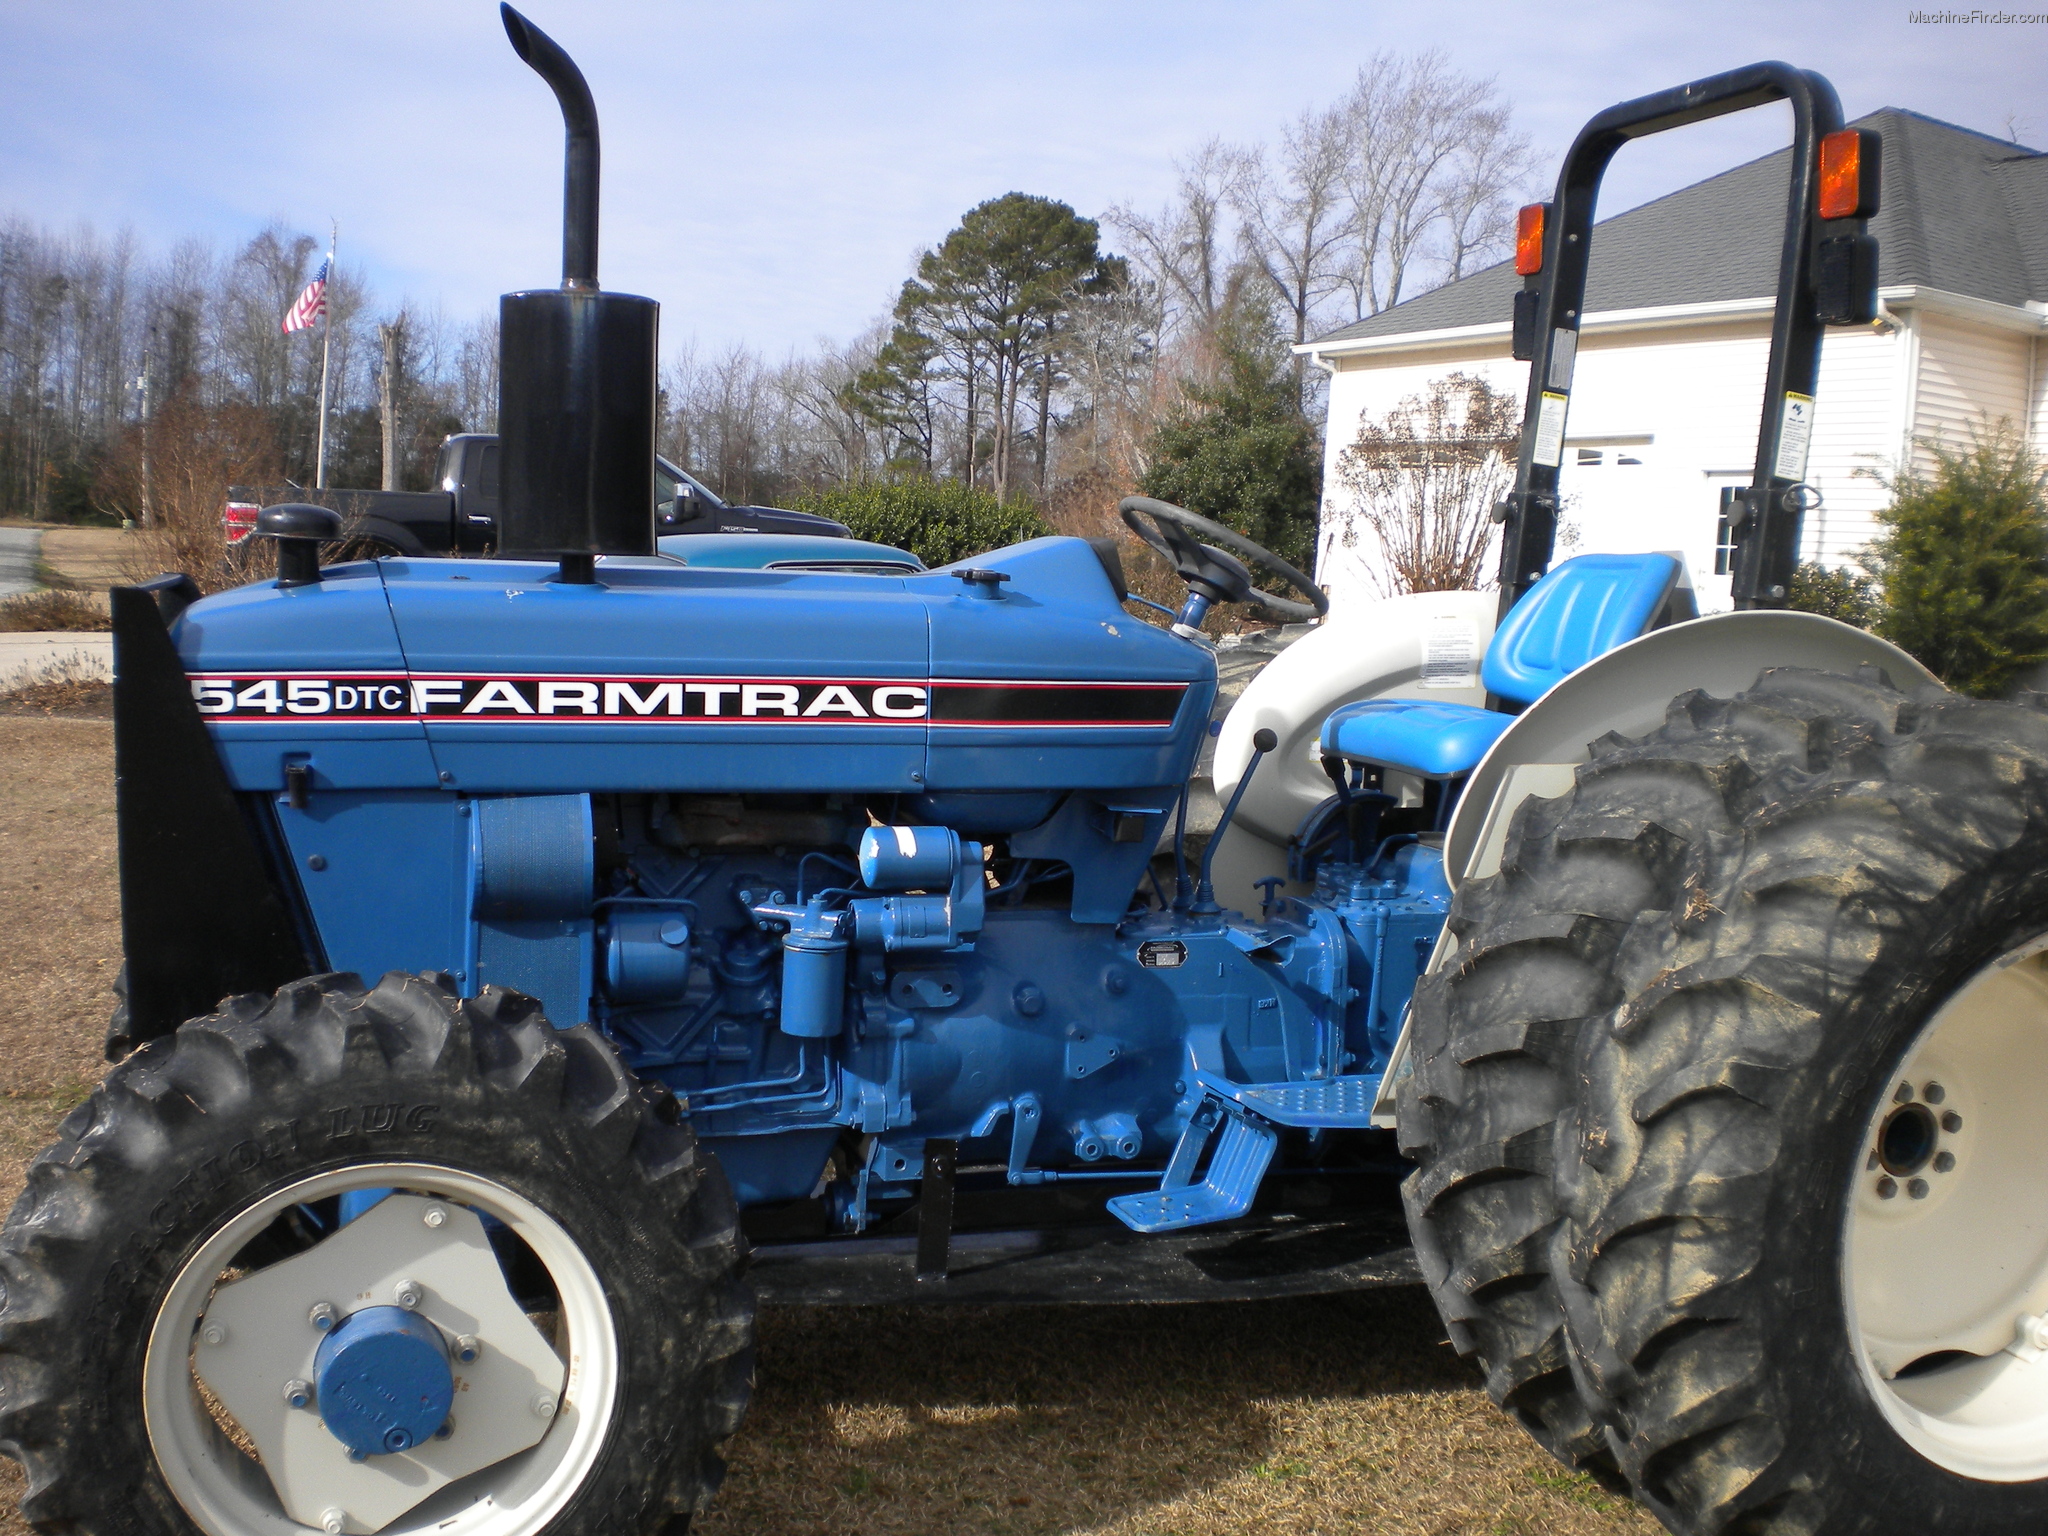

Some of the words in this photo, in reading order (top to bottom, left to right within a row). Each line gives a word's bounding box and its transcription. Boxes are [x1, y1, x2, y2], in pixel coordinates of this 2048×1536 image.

[190, 679, 332, 714] 545
[334, 684, 403, 711] DTC
[410, 679, 928, 719] FARMTRAC
